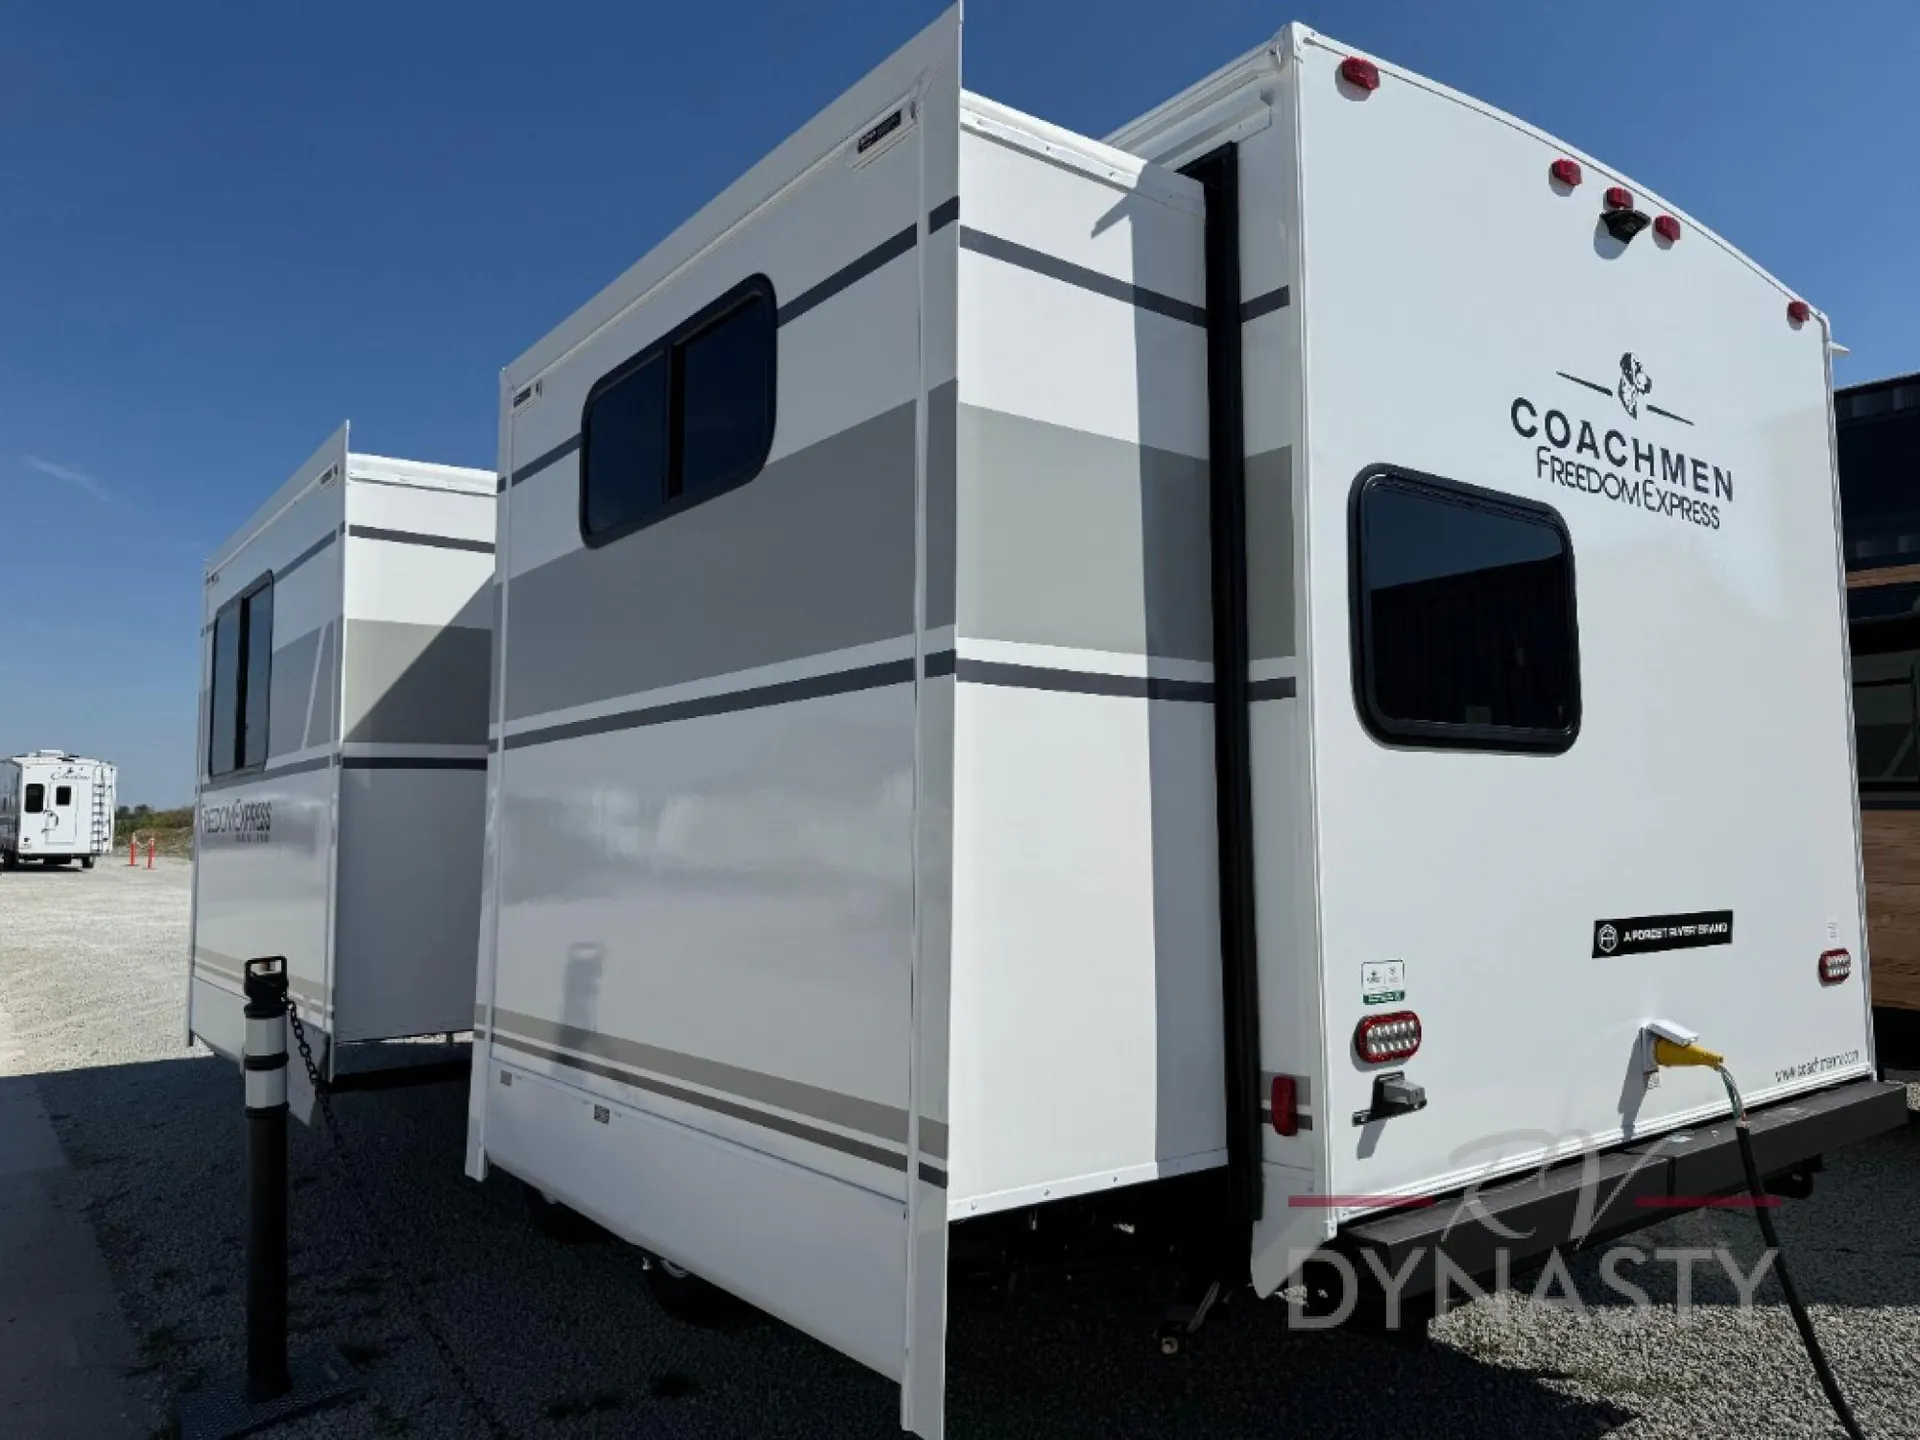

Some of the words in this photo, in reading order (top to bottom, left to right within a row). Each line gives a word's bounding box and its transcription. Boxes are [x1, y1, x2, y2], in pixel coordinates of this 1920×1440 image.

[1510, 397, 1733, 502] COACHMEN
[1623, 931, 1632, 942] A
[1698, 922, 1728, 935] BRAND
